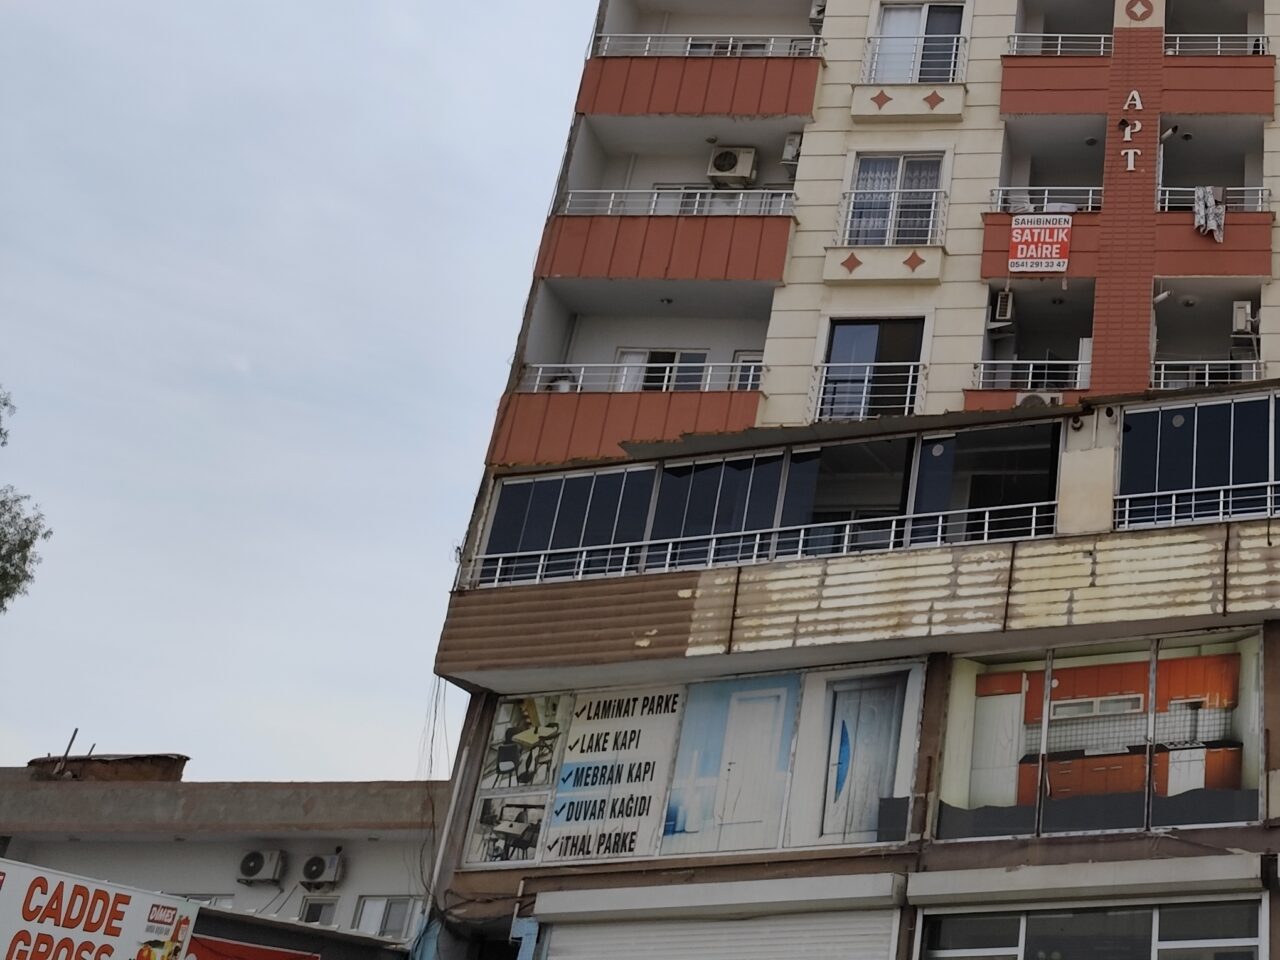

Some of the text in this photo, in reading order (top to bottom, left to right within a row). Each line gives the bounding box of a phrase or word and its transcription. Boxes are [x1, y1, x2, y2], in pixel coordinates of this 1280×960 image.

[1121, 90, 1144, 171] APT
[1012, 228, 1069, 242] SATILIK
[641, 694, 679, 716] PARKE
[580, 729, 641, 753] LAKE KAPI
[573, 761, 656, 787] MEBRAN KAPI
[566, 794, 652, 822] DUVAR KAĞIDI
[597, 832, 637, 854] PARKE
[22, 876, 131, 938] CADDE
